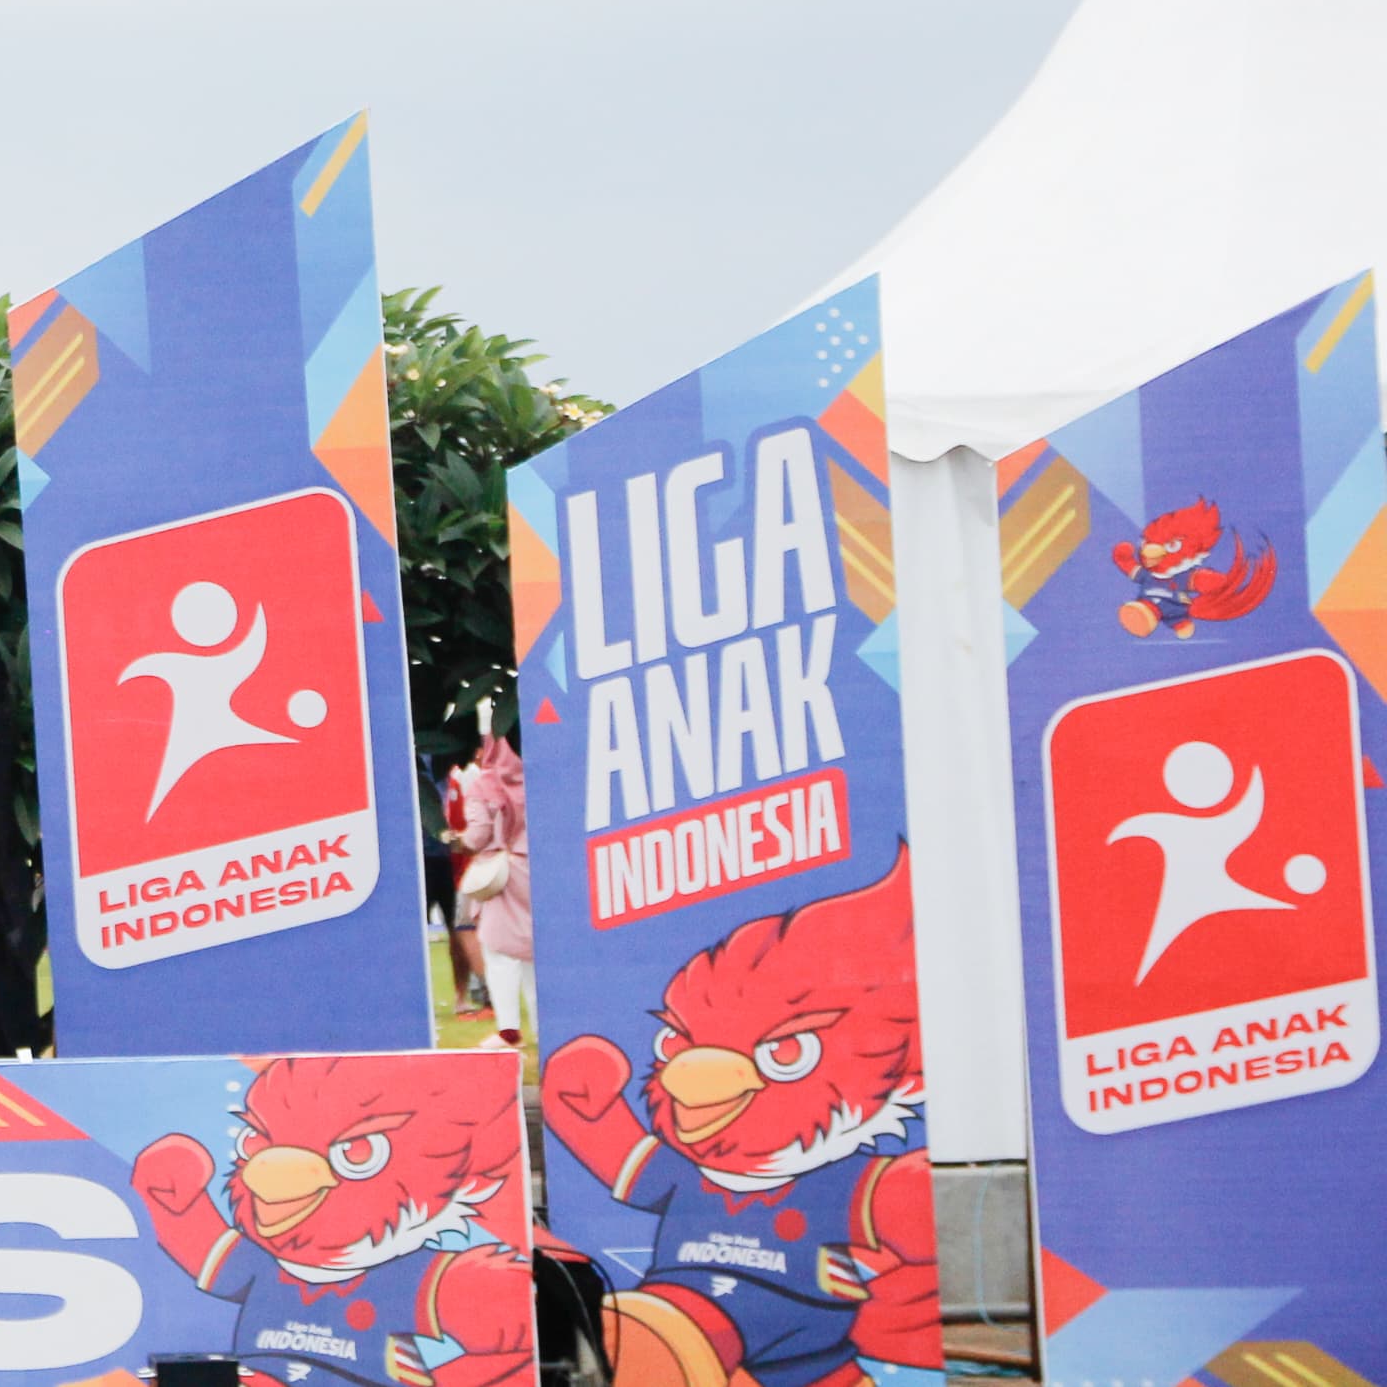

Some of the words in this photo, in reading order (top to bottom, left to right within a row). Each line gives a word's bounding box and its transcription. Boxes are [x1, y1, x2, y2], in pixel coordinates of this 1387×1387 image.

[567, 428, 837, 680] LIGA
[586, 614, 846, 832] ANAK
[99, 870, 206, 914] LIGA
[218, 834, 352, 886] ANAK
[596, 781, 842, 920] INDONESIA
[101, 871, 354, 950] INDONESIA
[1086, 1035, 1197, 1077] LIGA
[1212, 1003, 1349, 1053] ANAK
[1088, 1041, 1352, 1113] INDONESIA
[677, 1241, 786, 1274] INDONESIA
[256, 1328, 357, 1361] INDONESIA
